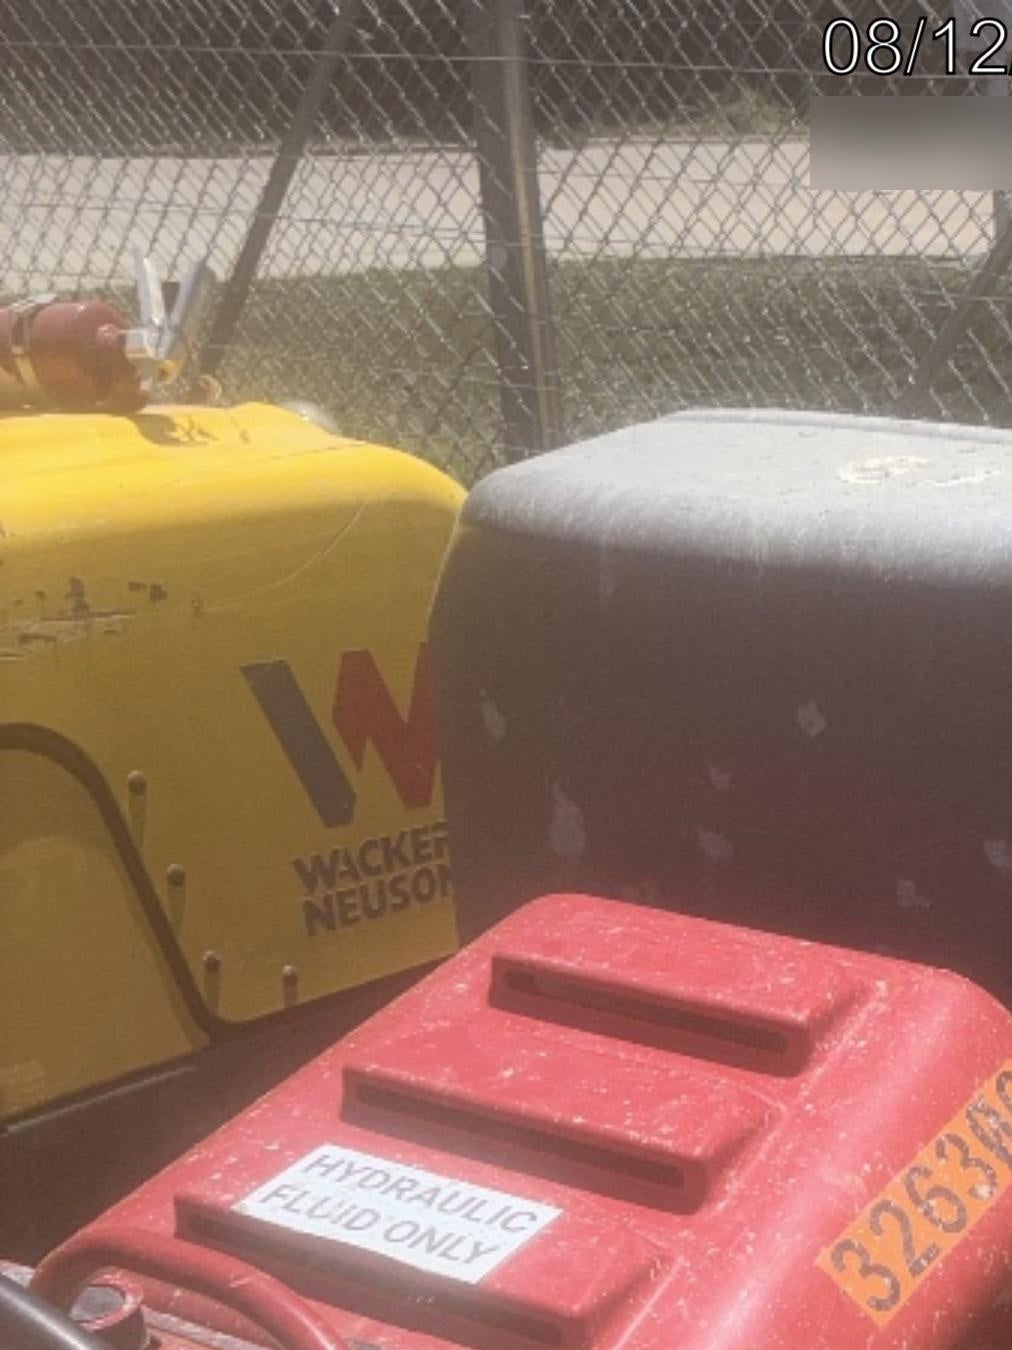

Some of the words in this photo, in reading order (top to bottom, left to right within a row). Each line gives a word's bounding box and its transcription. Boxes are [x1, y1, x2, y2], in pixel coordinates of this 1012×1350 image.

[259, 1183, 383, 1232] FLUID
[383, 1219, 499, 1266] ONLY
[302, 1153, 539, 1234] HYDRAULIC
